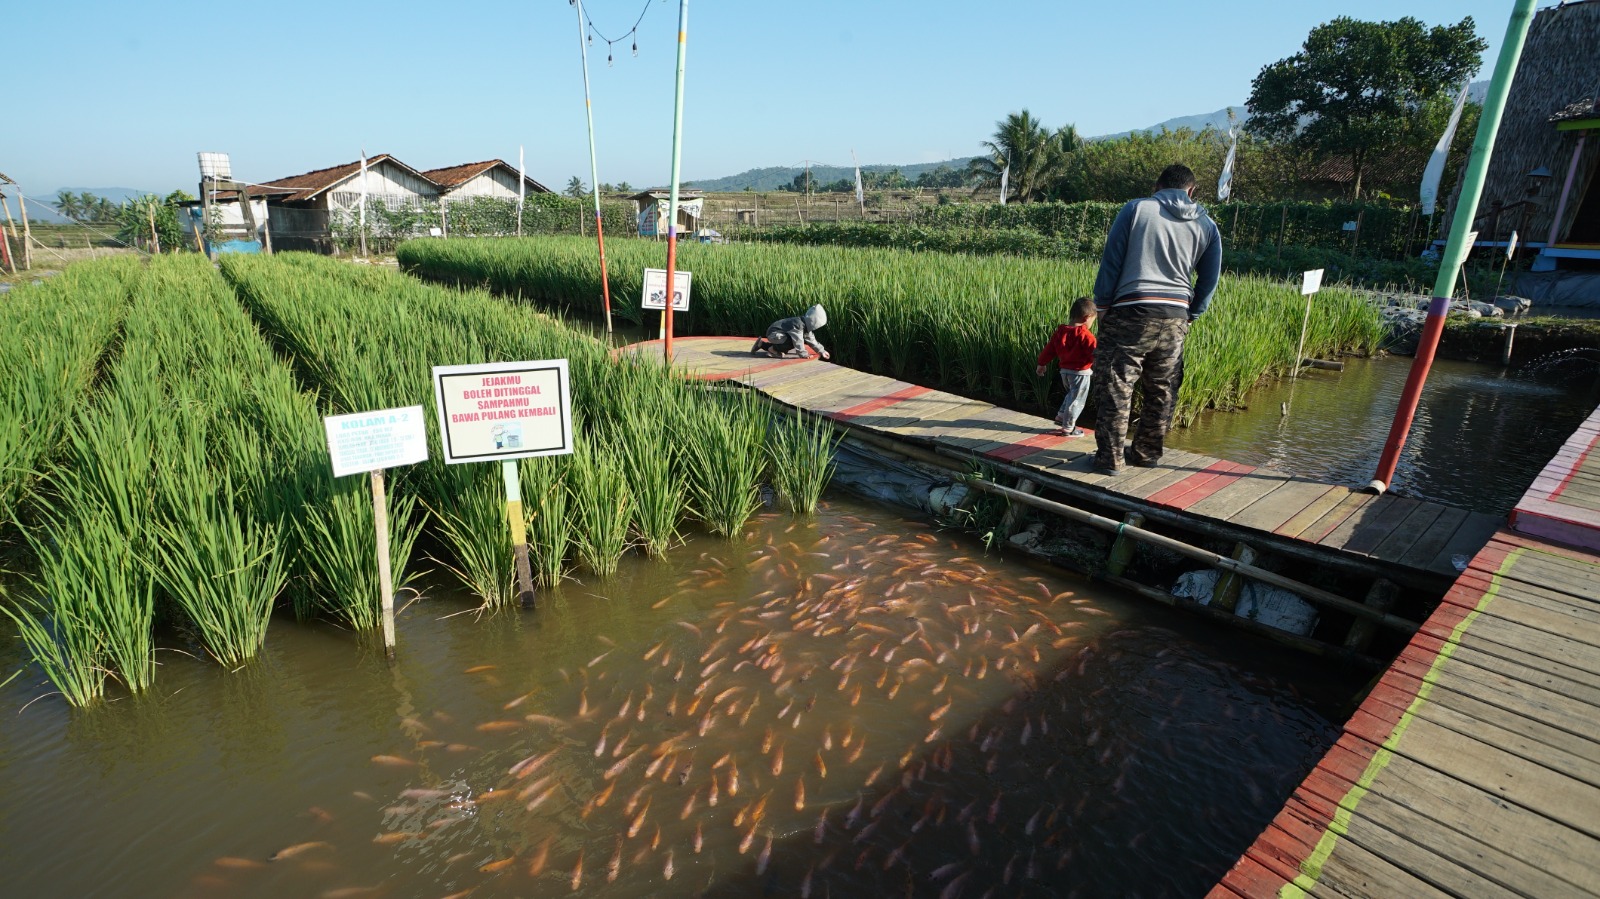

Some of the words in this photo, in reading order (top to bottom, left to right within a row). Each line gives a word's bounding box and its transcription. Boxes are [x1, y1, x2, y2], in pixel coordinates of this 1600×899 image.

[482, 375, 521, 387] JEJAKMU
[463, 389, 492, 399] BOLEH
[494, 385, 541, 398] DITINGGAL
[477, 397, 529, 410] SAMPAHMU
[452, 412, 480, 423] BAWA
[481, 409, 516, 421] PULANG
[518, 406, 556, 418] KEMBALI
[341, 416, 385, 430] KOLAM
